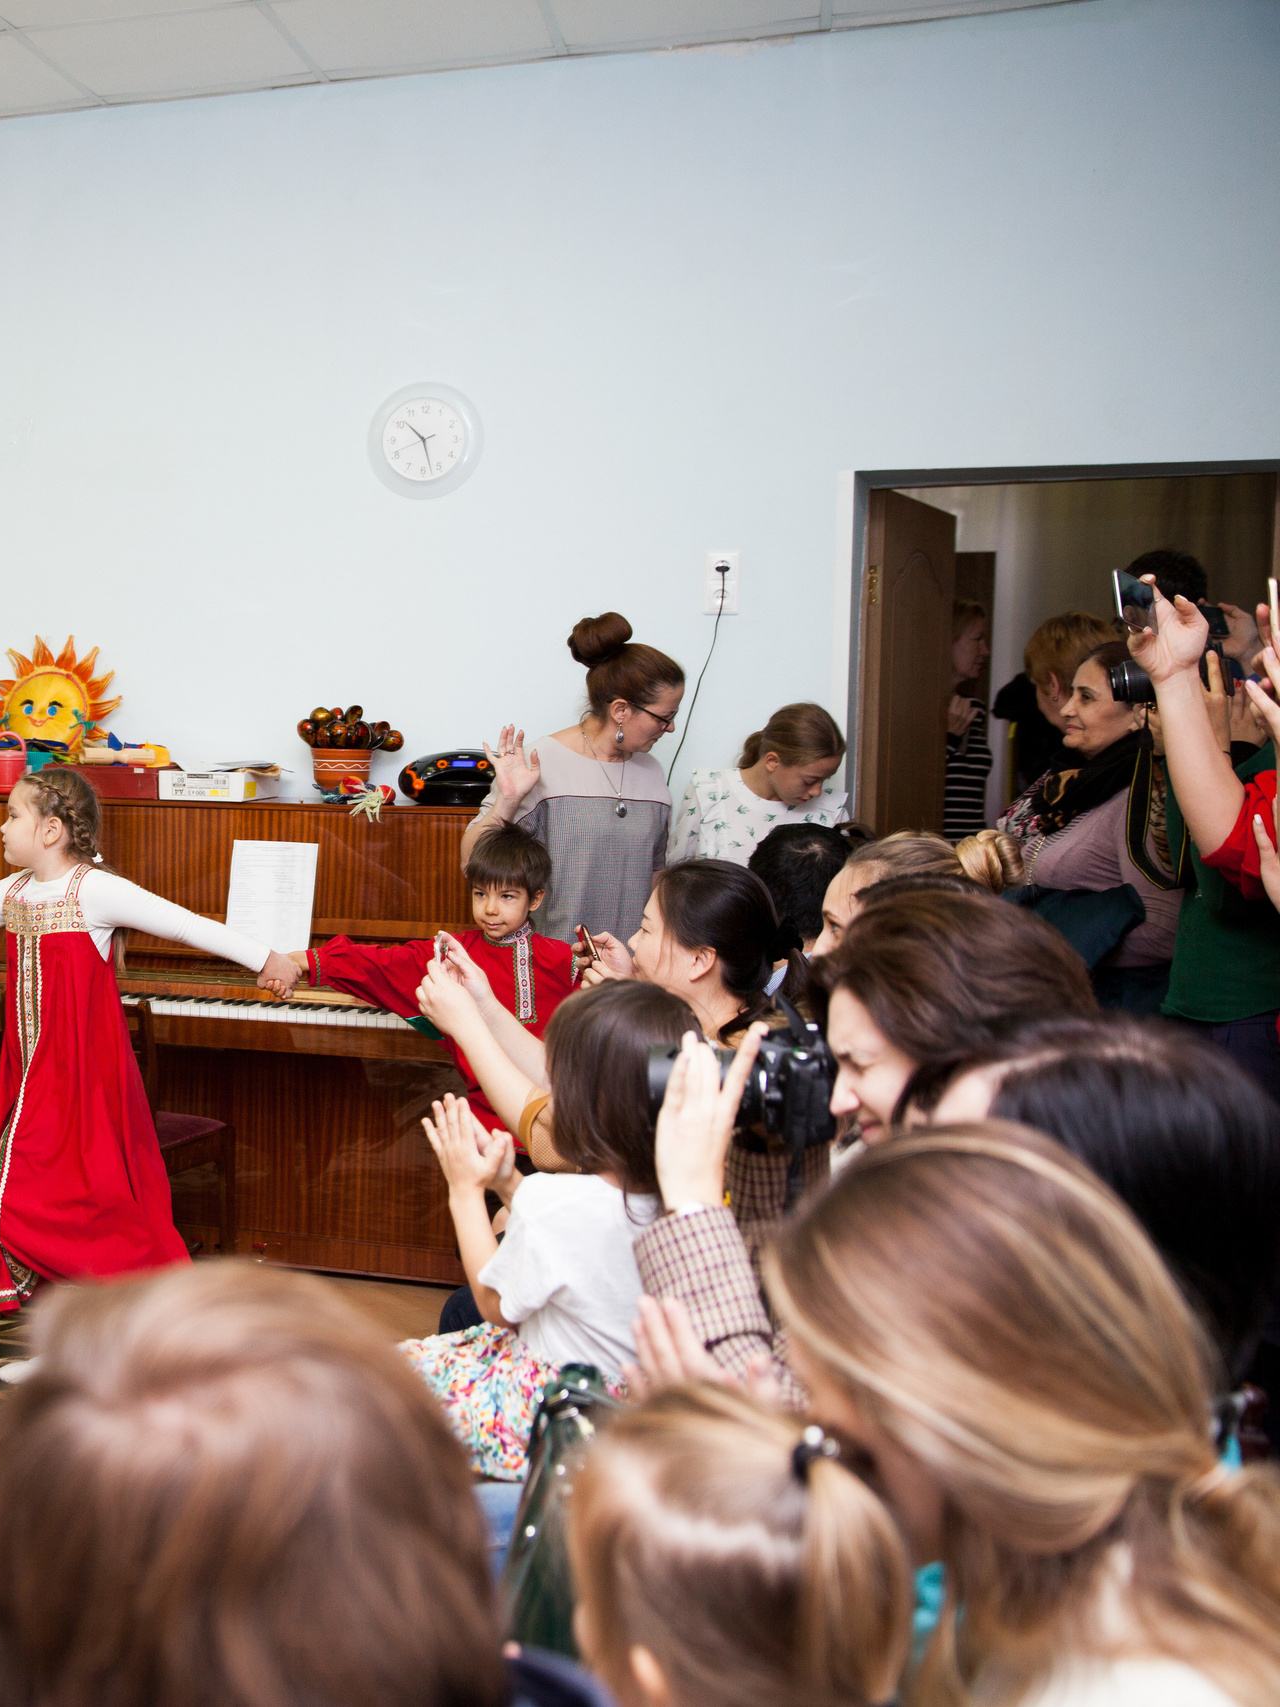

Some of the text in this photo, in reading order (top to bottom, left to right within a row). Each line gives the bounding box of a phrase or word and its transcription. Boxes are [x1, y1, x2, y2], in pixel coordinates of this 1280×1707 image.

[407, 409, 415, 417] 11
[421, 405, 431, 414] 12
[395, 420, 405, 429] 10
[448, 419, 455, 429] 2
[390, 436, 396, 445] 9
[452, 435, 459, 444] 3
[394, 450, 400, 459] 8
[448, 450, 454, 458] 4
[406, 462, 412, 471] 7
[420, 466, 426, 475] 6
[436, 462, 442, 471] 5
